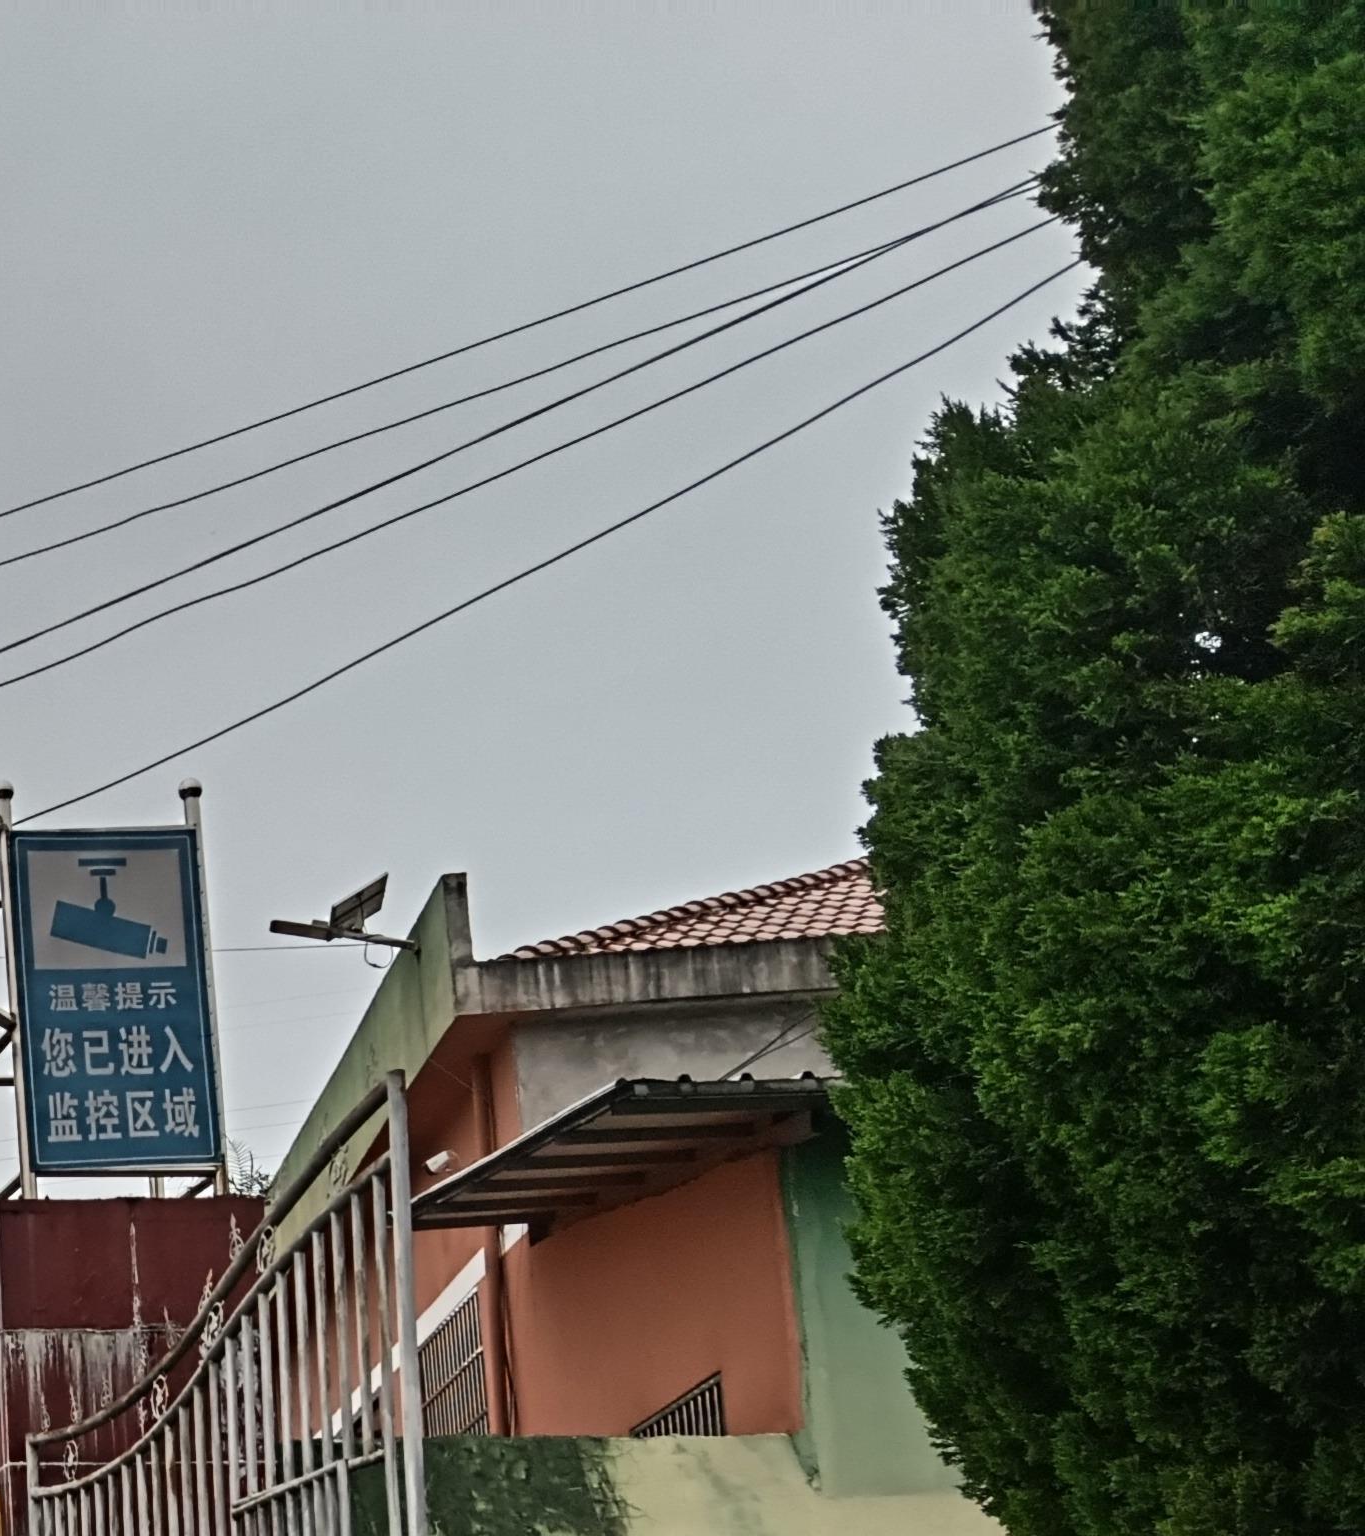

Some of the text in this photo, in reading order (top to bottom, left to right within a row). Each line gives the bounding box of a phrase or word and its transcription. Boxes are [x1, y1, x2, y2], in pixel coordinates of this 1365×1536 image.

[49, 981, 177, 1012] 温馨提示
[41, 1025, 194, 1078] 您已进入
[47, 1087, 200, 1143] 监控区域
